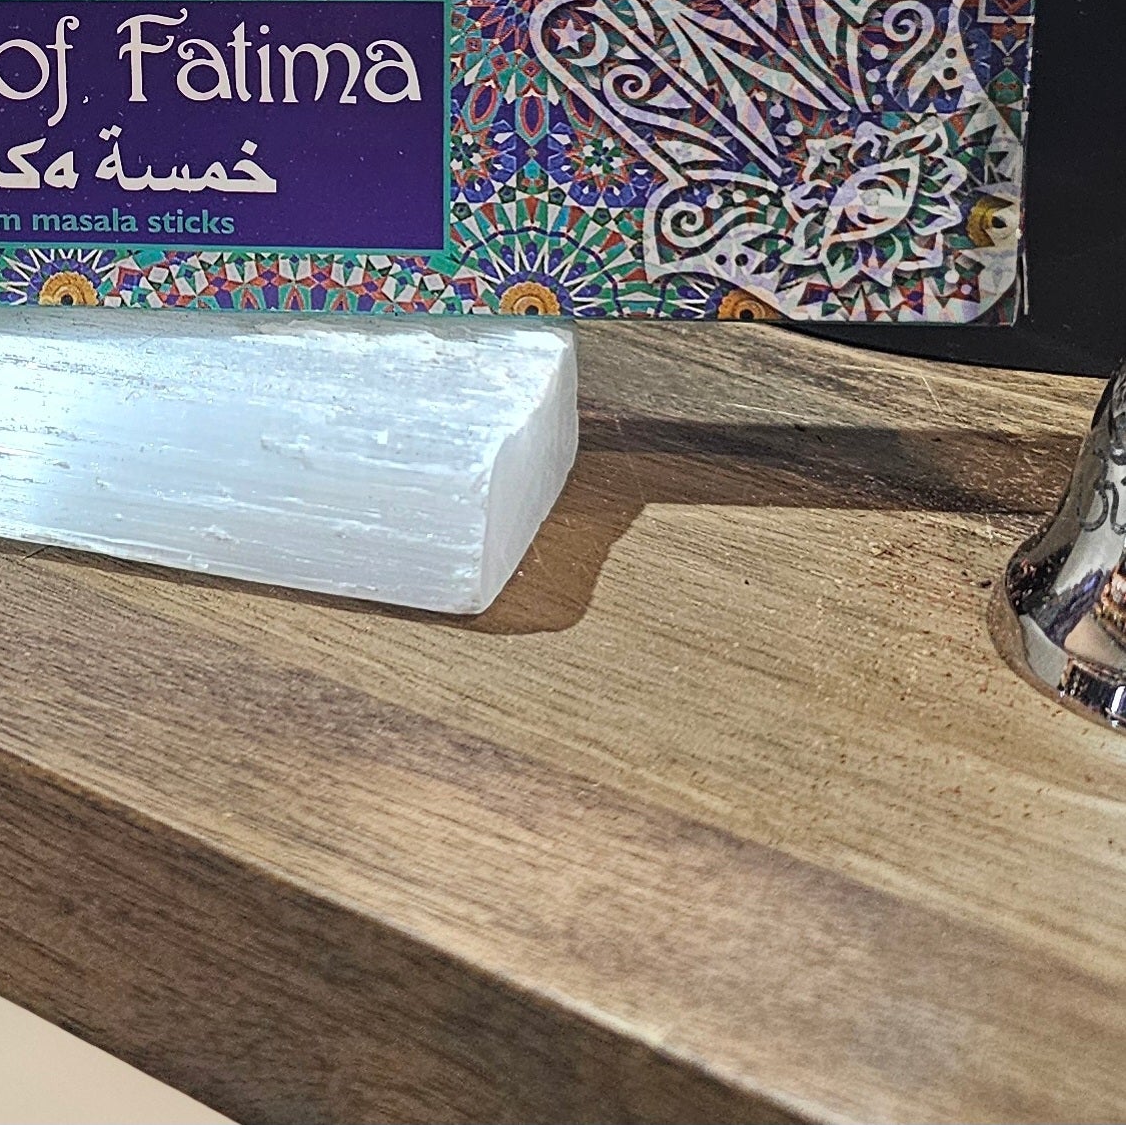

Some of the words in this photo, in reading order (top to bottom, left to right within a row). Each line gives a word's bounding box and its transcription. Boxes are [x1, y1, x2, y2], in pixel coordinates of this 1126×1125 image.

[116, 7, 422, 104] Fatima
[94, 124, 278, 194] خمسة
[31, 207, 139, 234] masala
[147, 208, 236, 235] sticks
